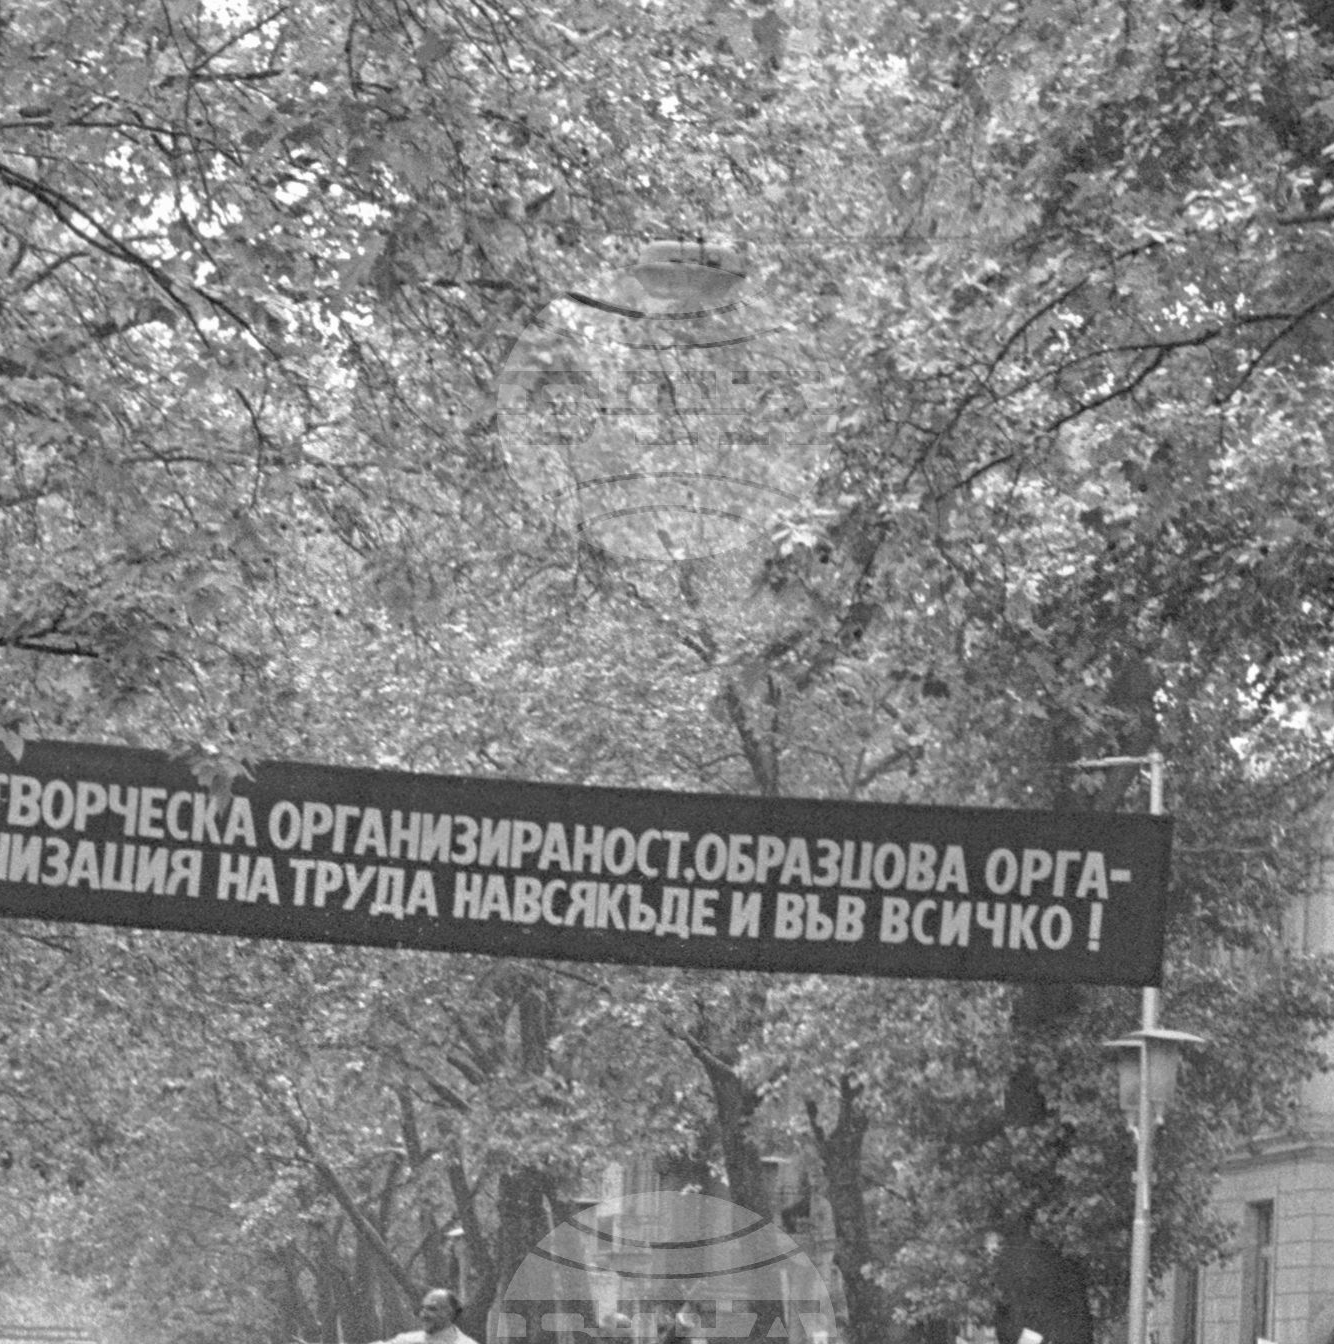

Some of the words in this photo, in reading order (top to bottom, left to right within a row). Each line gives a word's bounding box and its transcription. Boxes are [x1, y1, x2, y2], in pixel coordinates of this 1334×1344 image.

[216, 852, 281, 905] НА
[288, 857, 439, 921] ТРУДА
[452, 871, 720, 940] НАВСЯКЪДЕ
[728, 890, 763, 939] И
[985, 847, 1132, 900] ОРГА-
